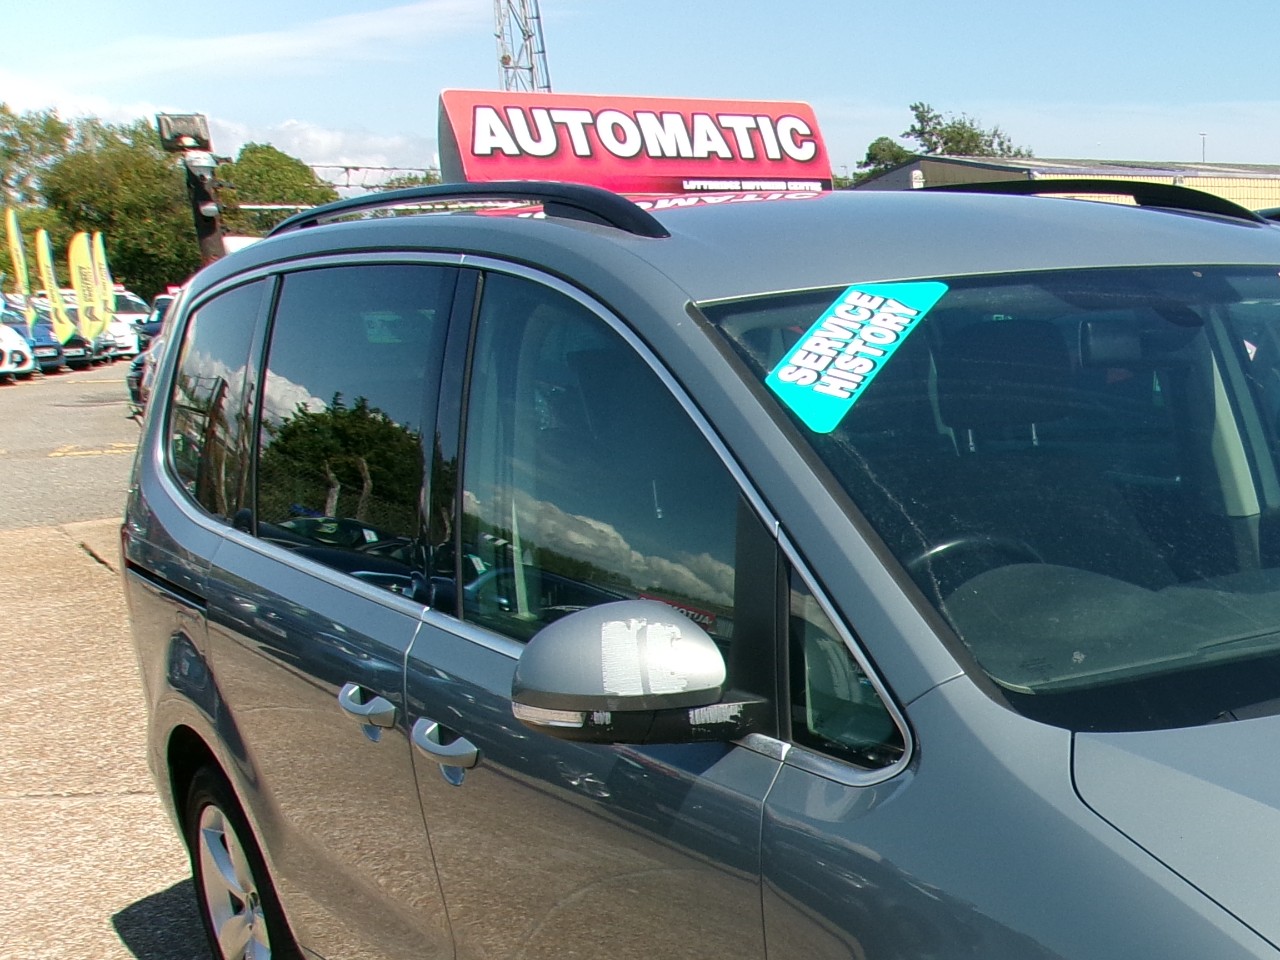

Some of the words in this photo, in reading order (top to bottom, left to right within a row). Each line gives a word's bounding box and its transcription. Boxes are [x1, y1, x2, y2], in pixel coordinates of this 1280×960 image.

[472, 105, 817, 162] AUTOMATIC
[777, 289, 887, 387] SERVICE
[812, 297, 922, 400] HISTORY
